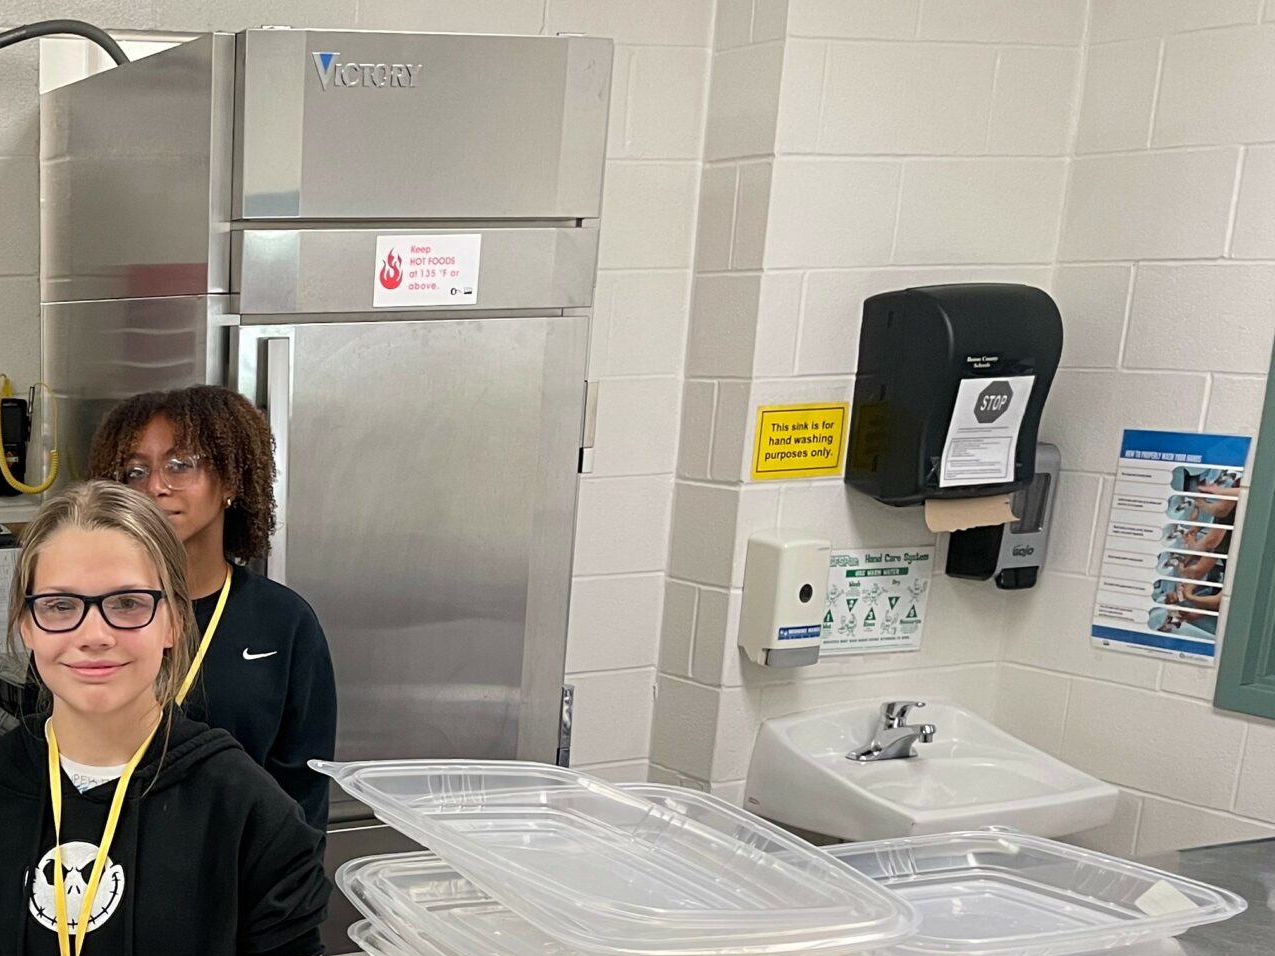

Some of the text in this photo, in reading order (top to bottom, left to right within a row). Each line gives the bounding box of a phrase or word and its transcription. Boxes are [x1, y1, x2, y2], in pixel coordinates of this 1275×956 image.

[312, 51, 423, 91] VICTORY
[410, 245, 432, 255] Keep
[409, 256, 456, 266] HOT FOODS
[409, 270, 418, 278] at
[421, 269, 436, 278] 135
[980, 394, 1008, 412] STOP
[771, 420, 835, 432] This sink is for
[768, 433, 834, 446] hand washing
[764, 447, 833, 462] purposes only.
[865, 553, 883, 564] Hand
[884, 553, 902, 563] Care
[904, 551, 929, 565] System
